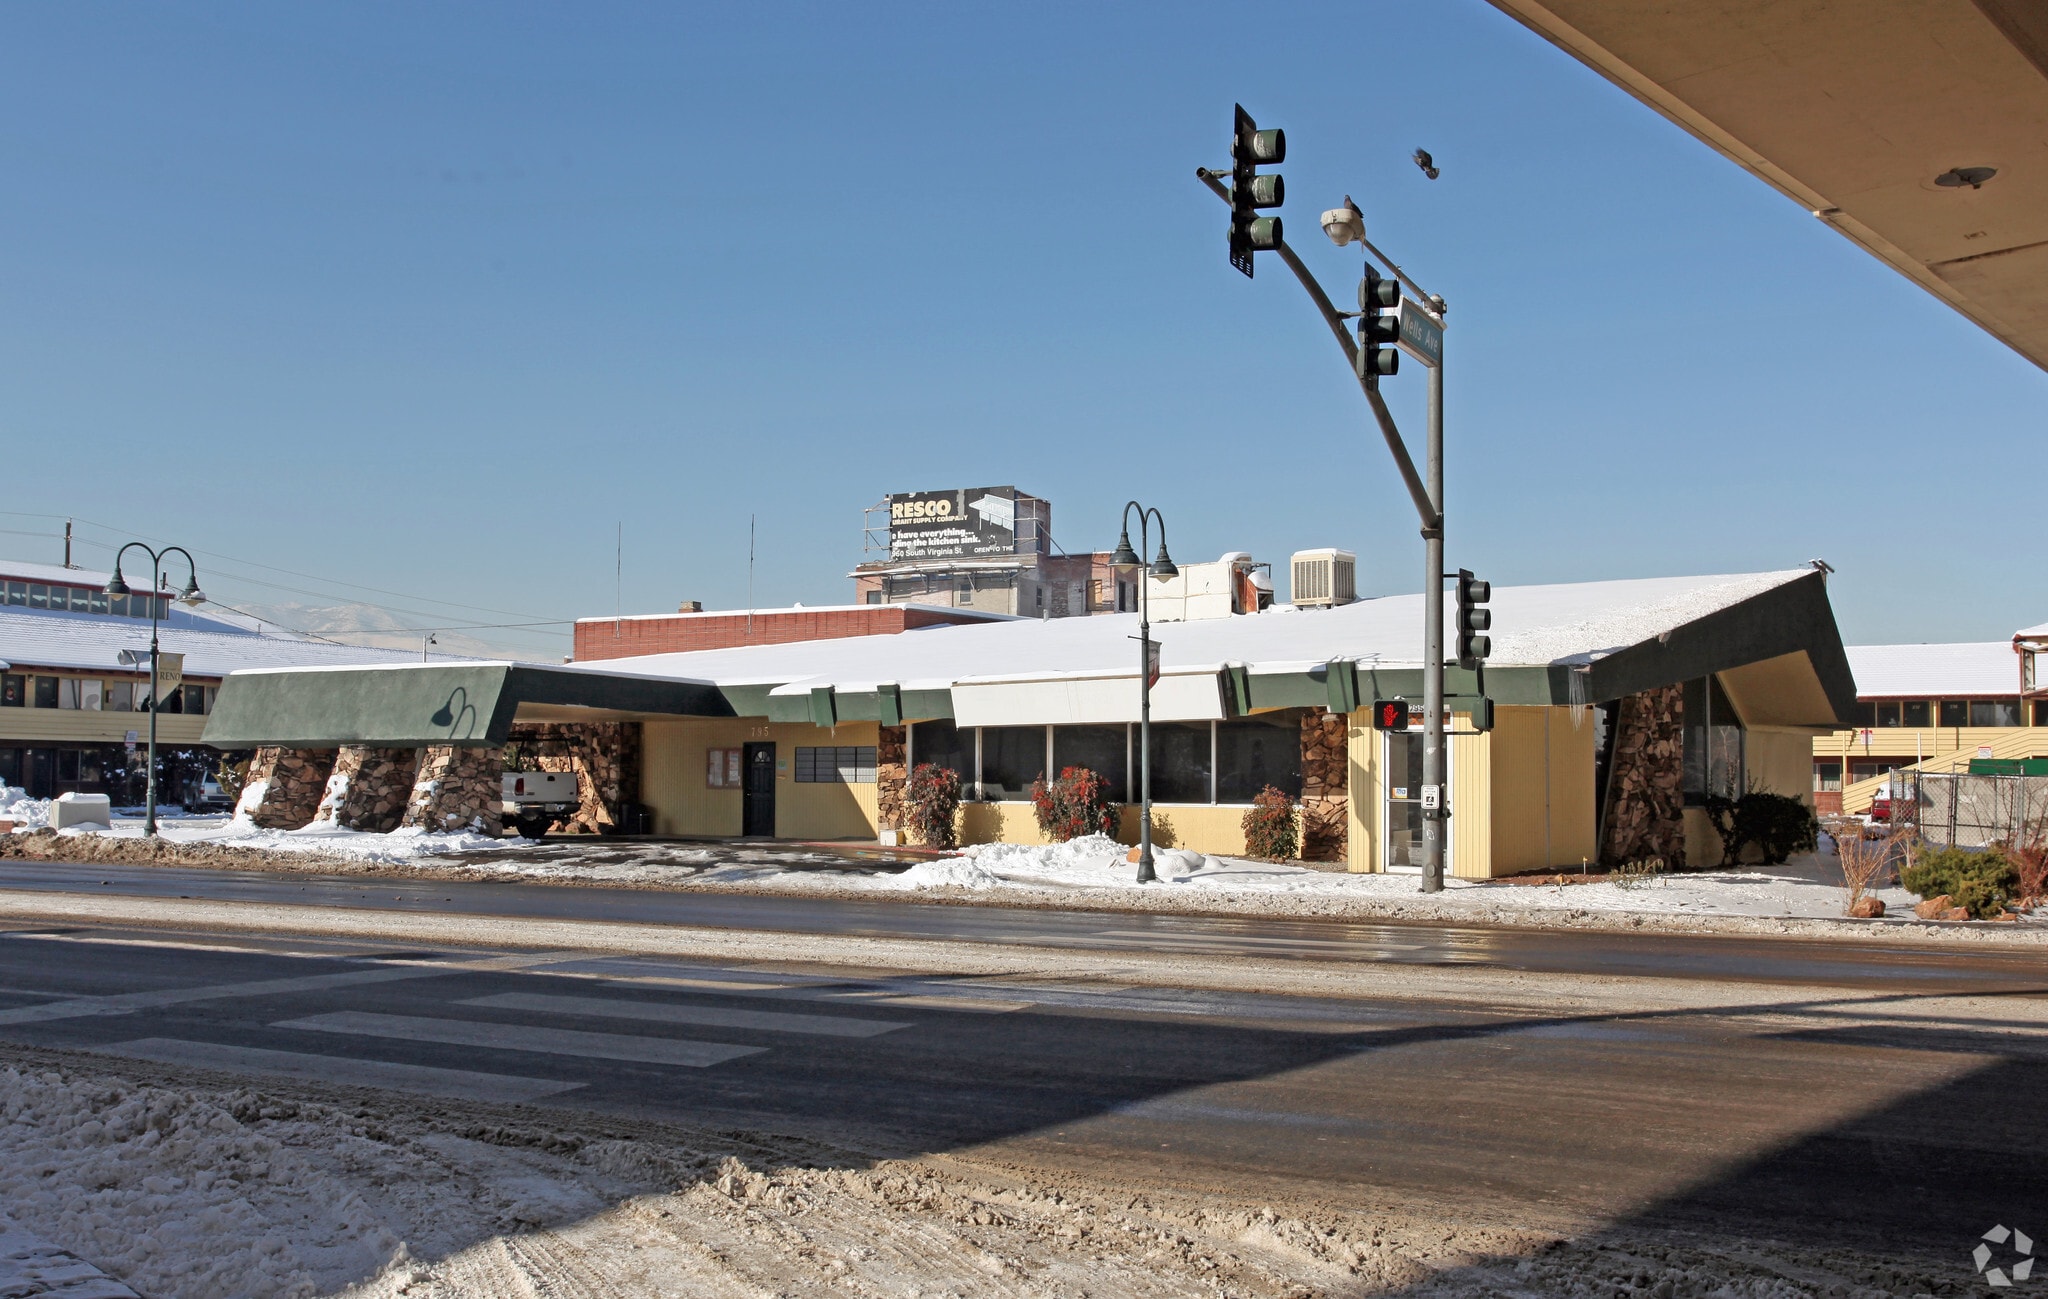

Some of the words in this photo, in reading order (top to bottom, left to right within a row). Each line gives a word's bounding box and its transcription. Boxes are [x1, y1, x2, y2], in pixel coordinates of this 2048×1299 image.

[1402, 312, 1422, 340] Wells
[1424, 330, 1438, 352] Ave
[892, 499, 952, 518] RESCO
[913, 516, 936, 524] SUPPLY
[897, 531, 919, 539] have
[913, 538, 928, 547] the
[928, 536, 960, 546] kitchen
[961, 534, 981, 544] sink.
[905, 549, 926, 557] South
[927, 548, 953, 557] Virginia
[954, 547, 964, 555] St.
[160, 671, 181, 681] RENO
[751, 726, 768, 737] 795
